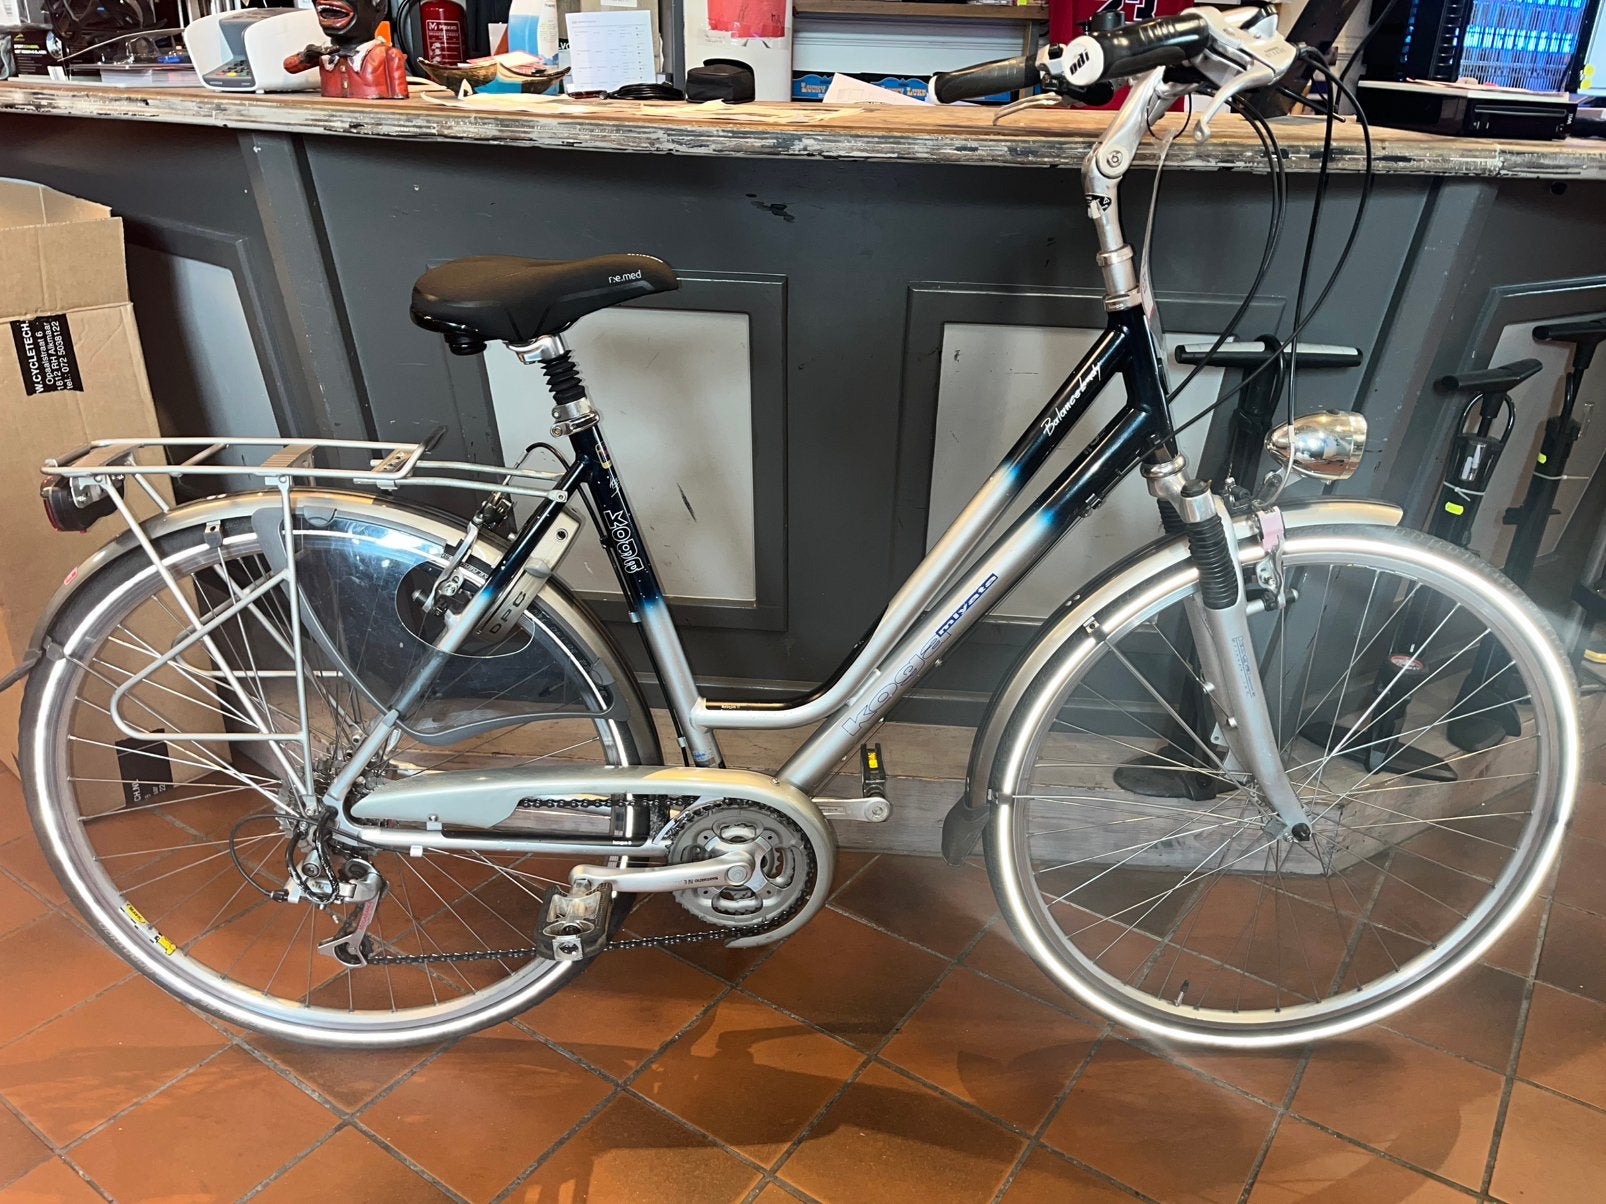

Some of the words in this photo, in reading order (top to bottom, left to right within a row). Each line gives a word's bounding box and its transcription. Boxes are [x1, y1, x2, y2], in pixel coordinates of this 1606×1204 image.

[1069, 49, 1090, 76] odi
[45, 322, 57, 355] Alkmaar
[51, 320, 66, 356] 5038122
[39, 336, 54, 385] Opaalstraat
[51, 356, 60, 370] RH
[59, 356, 70, 373] 072
[53, 370, 64, 391] 1812
[937, 573, 999, 637] miyata
